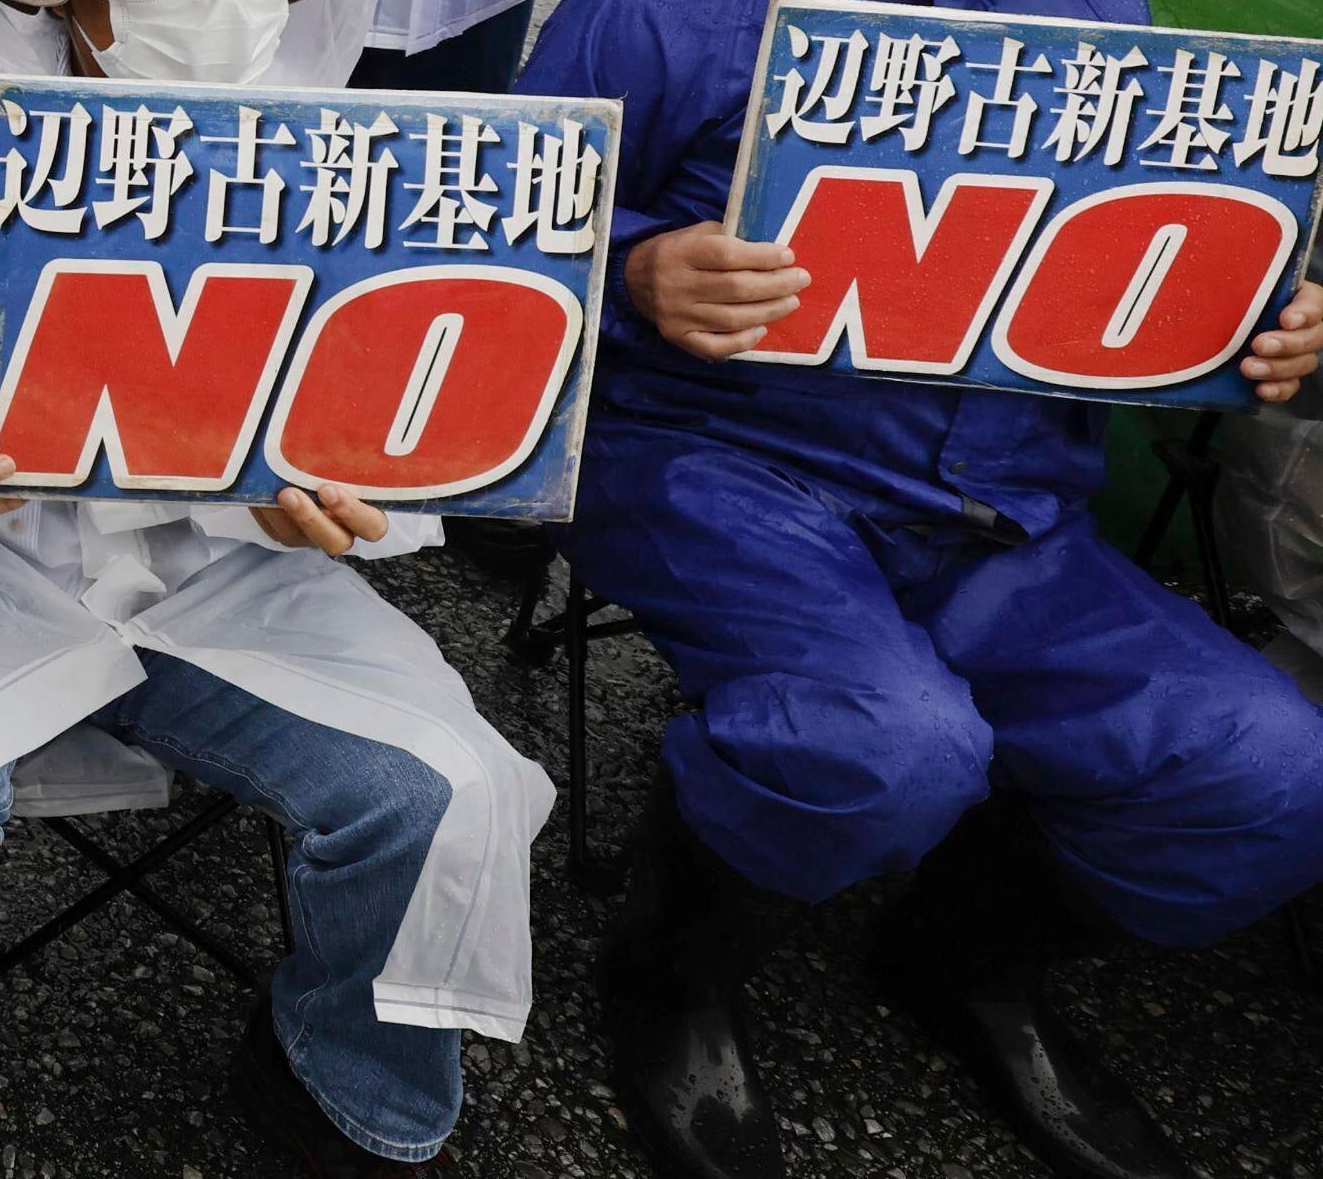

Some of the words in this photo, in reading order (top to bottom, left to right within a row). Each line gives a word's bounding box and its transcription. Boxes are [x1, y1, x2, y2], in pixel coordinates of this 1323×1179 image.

[766, 24, 1323, 177] 辺野古新基地
[727, 165, 1298, 390] NO
